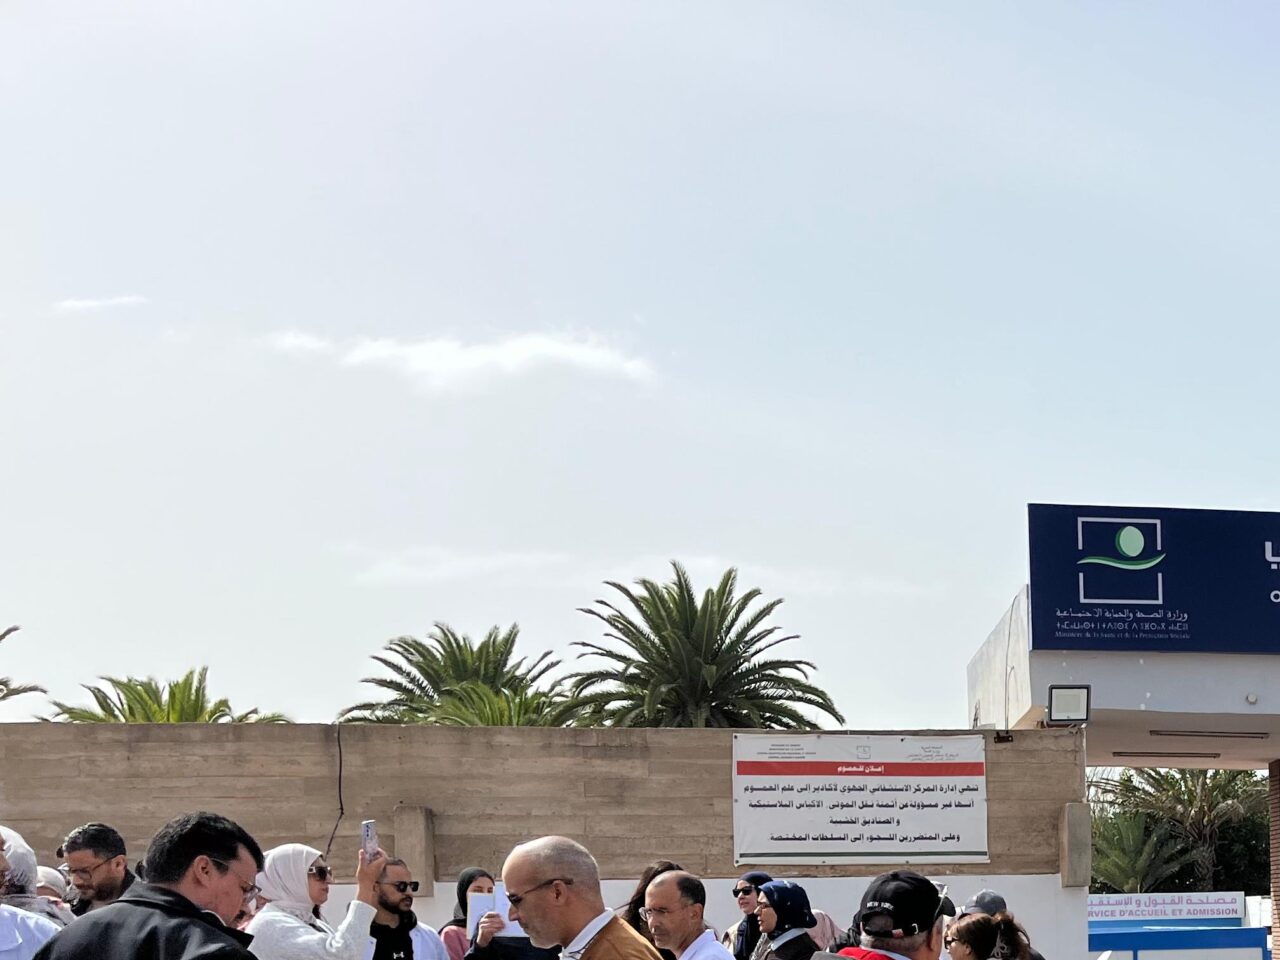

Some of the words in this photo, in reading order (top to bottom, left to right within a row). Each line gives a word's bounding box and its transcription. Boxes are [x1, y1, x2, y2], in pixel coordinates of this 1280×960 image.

[1143, 896, 1184, 908] القبول
[1185, 895, 1237, 905] مصلحة
[1119, 907, 1169, 917] D'ACCUEIL
[1171, 908, 1183, 916] ET
[1186, 907, 1238, 916] ADMISSION
